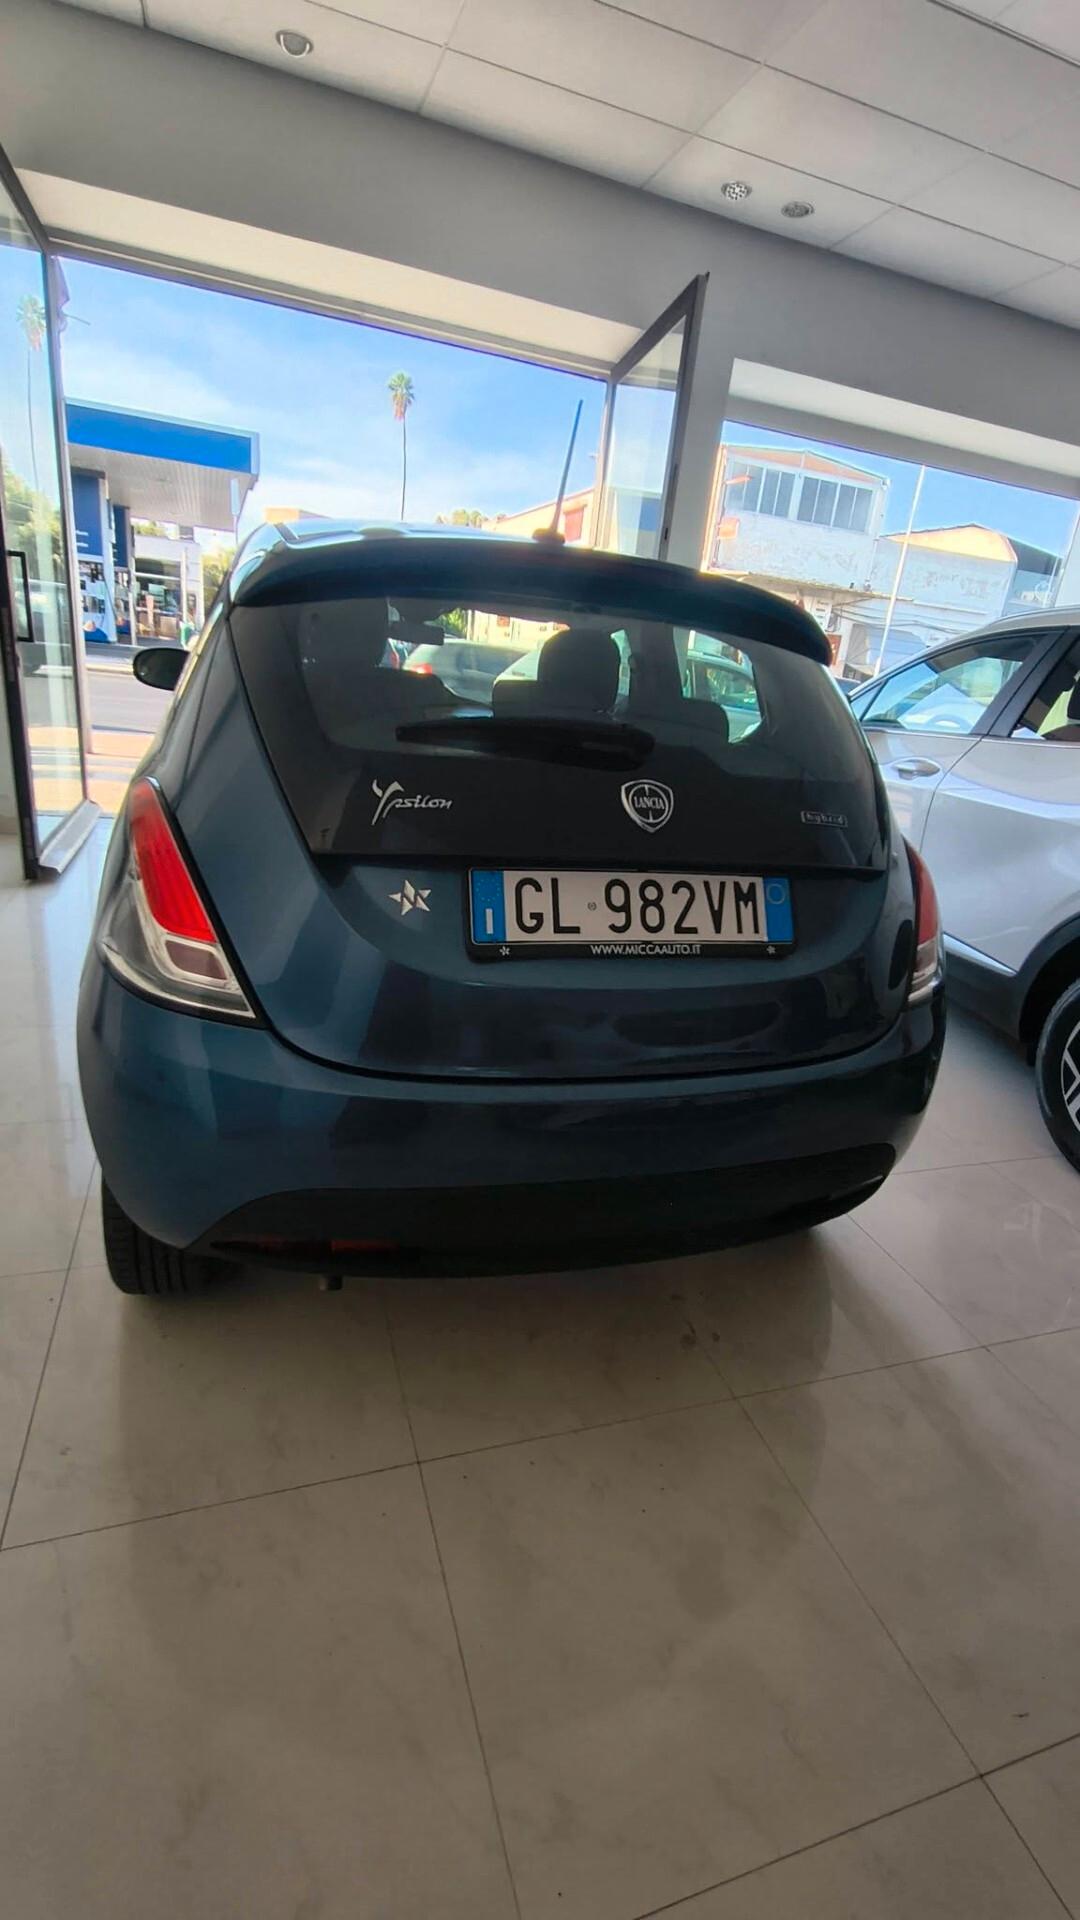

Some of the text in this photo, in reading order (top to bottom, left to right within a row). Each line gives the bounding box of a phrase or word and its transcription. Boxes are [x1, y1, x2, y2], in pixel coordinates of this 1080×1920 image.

[371, 779, 453, 826] Ypsilon
[633, 796, 665, 810] LANCIA
[514, 877, 760, 935] GL 982VM
[590, 944, 702, 955] WWW.MICCAAUTO.IT
